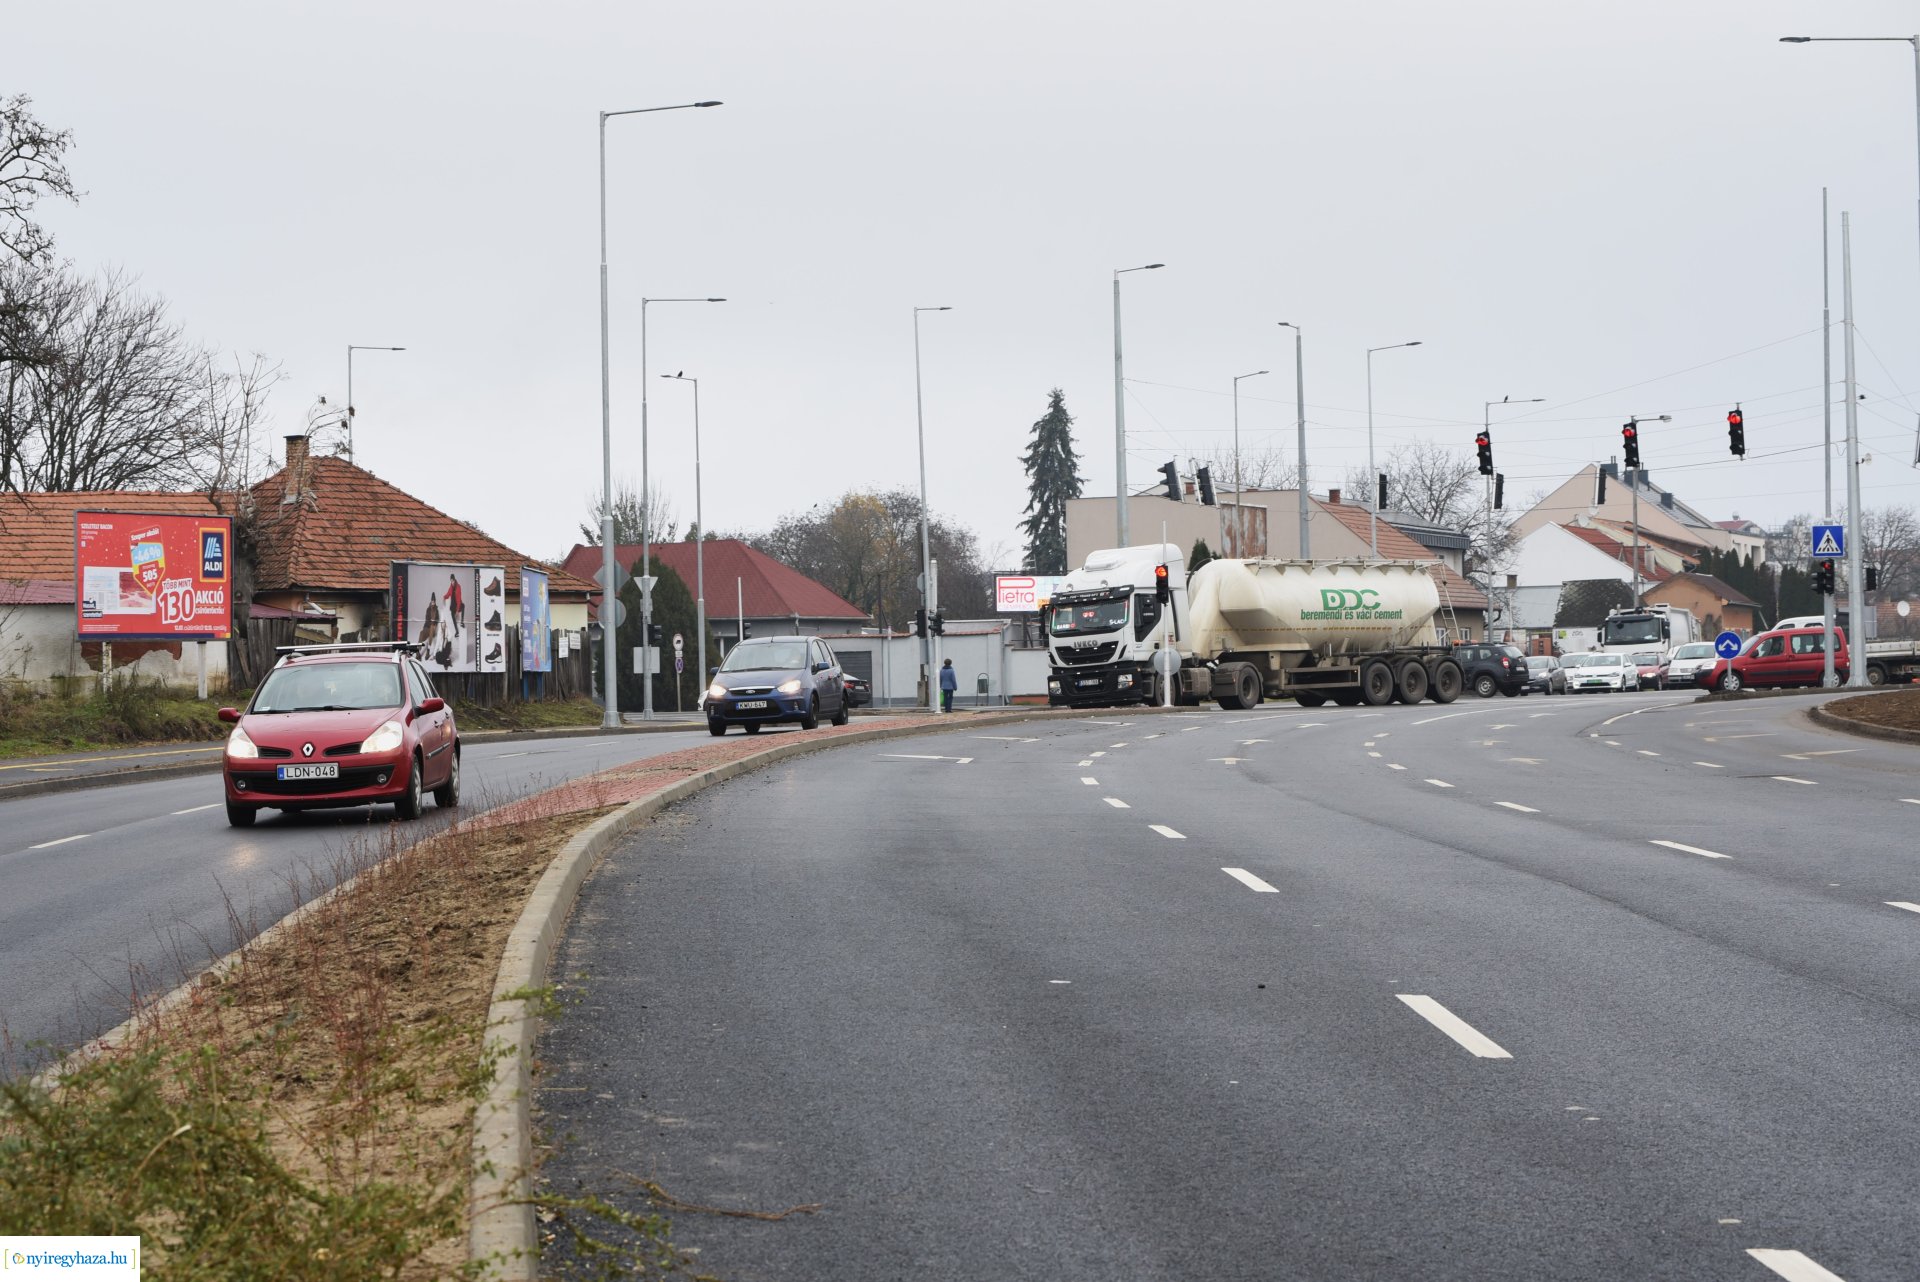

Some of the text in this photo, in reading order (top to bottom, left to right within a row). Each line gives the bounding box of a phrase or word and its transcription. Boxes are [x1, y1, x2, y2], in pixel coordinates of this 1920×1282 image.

[204, 561, 222, 571] ALDI
[143, 569, 157, 582] 505
[163, 581, 177, 590] TÖBB
[178, 579, 191, 588] MINT
[998, 577, 1035, 603] Pietra
[159, 586, 224, 621] 130 AKCIÓ
[1320, 589, 1381, 611] DDC
[1301, 609, 1402, 620] beremendi és váci cement
[1073, 639, 1098, 648] IVECO
[286, 766, 336, 778] LDN-048
